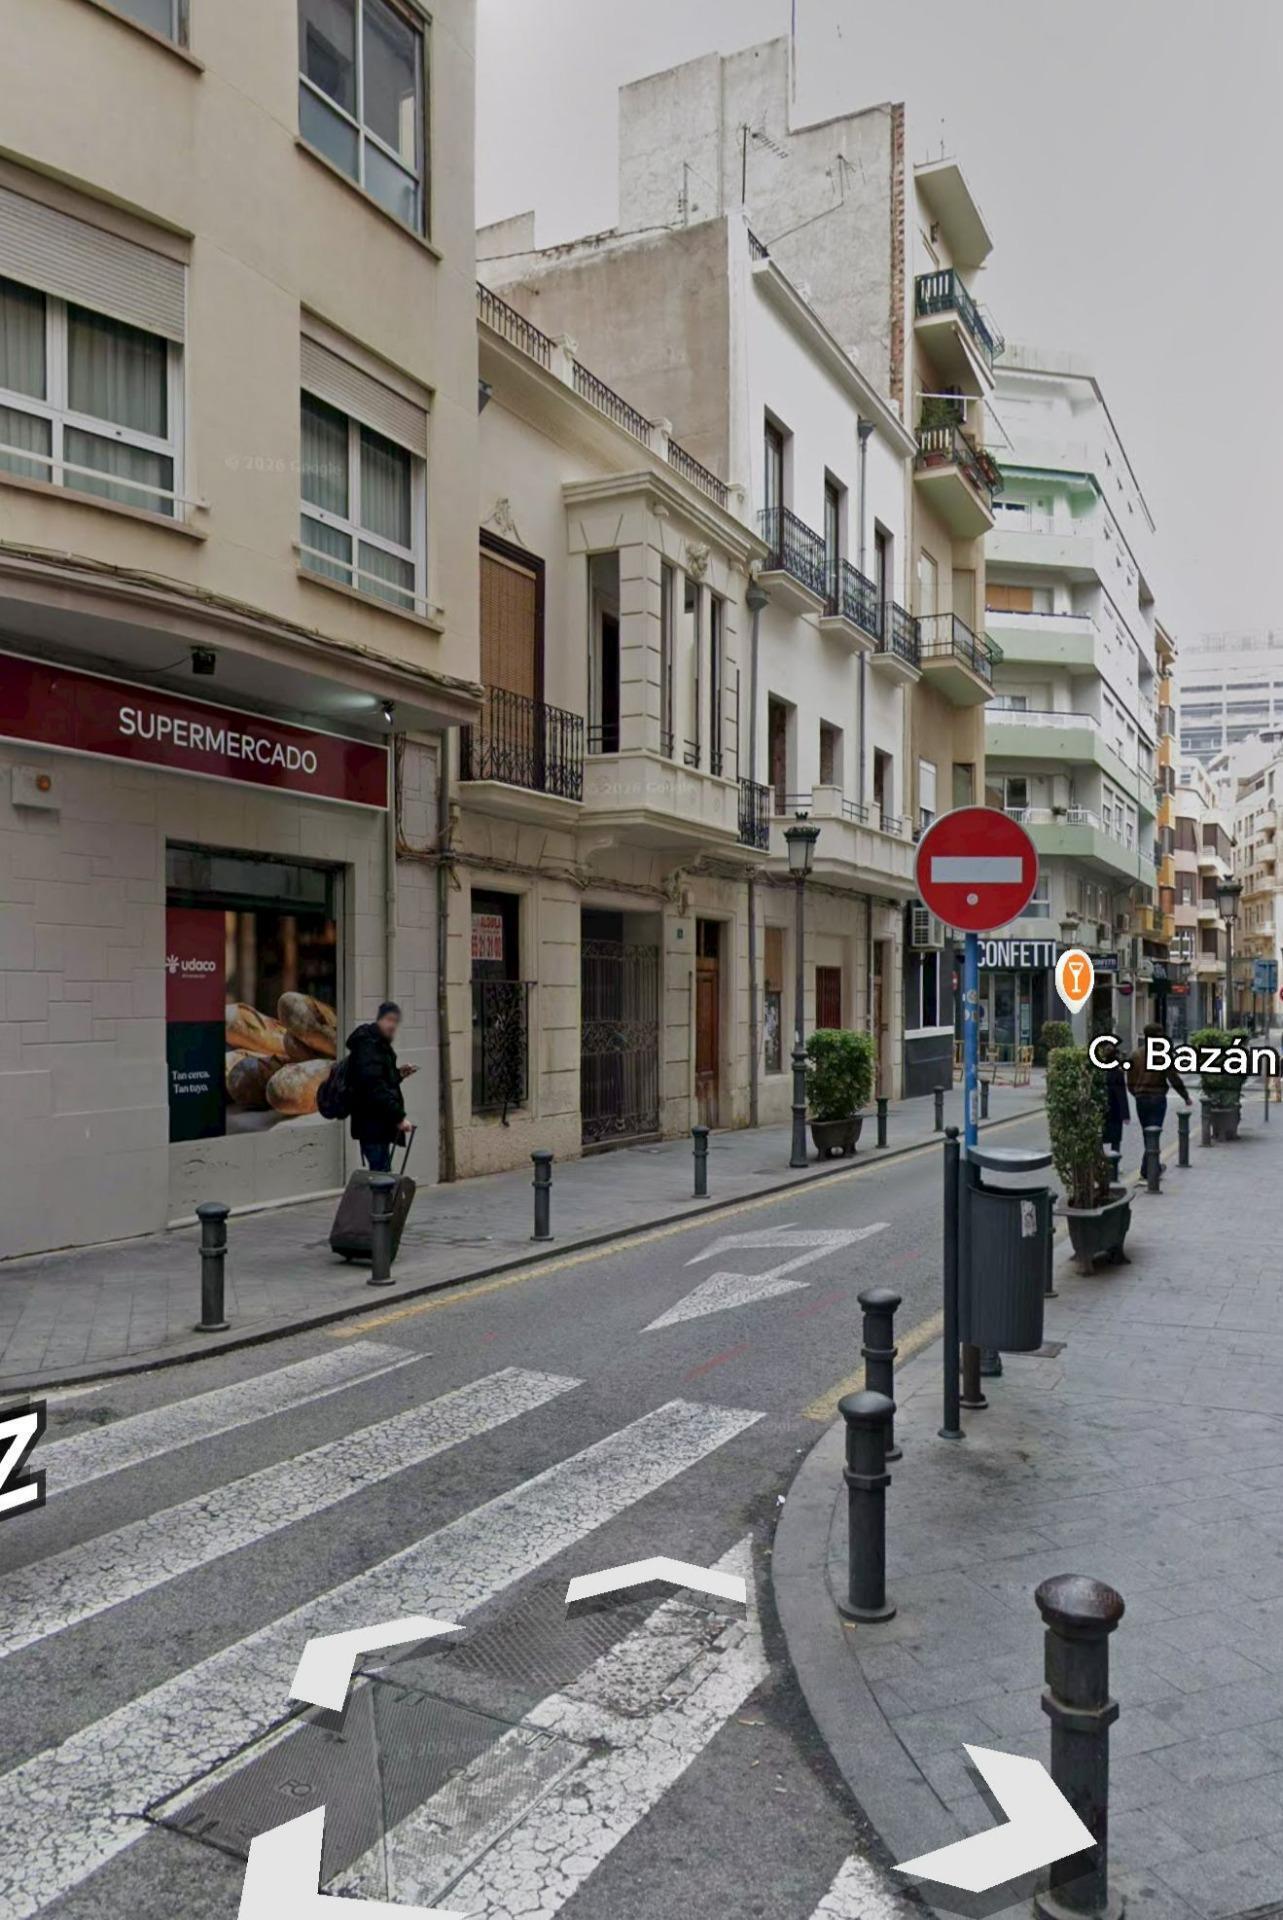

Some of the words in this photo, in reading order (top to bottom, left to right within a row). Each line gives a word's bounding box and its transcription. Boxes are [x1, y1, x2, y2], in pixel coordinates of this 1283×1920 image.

[119, 707, 317, 773] SUPERMERCADO
[182, 958, 216, 972] udaco
[172, 1070, 187, 1081] Tan
[174, 1083, 188, 1095] Tan
